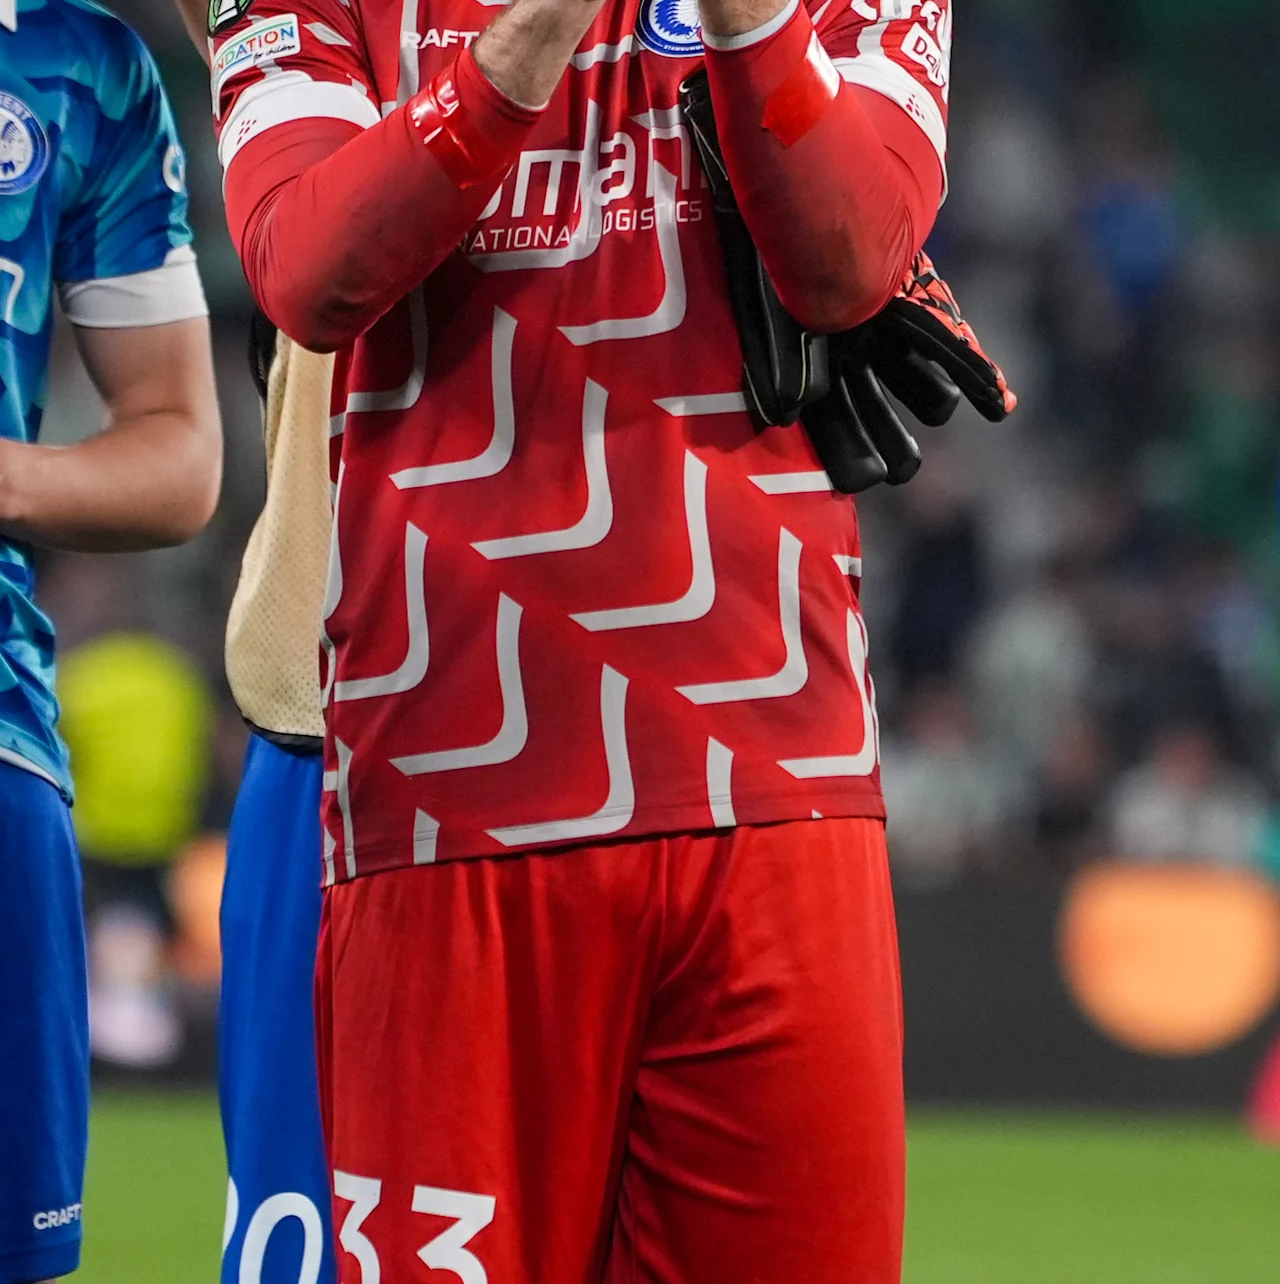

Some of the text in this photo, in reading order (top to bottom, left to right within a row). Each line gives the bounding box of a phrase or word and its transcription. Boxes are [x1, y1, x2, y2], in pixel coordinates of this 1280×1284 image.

[477, 132, 710, 222] man
[32, 1203, 82, 1231] CRAFT
[333, 1169, 497, 1284] 33
